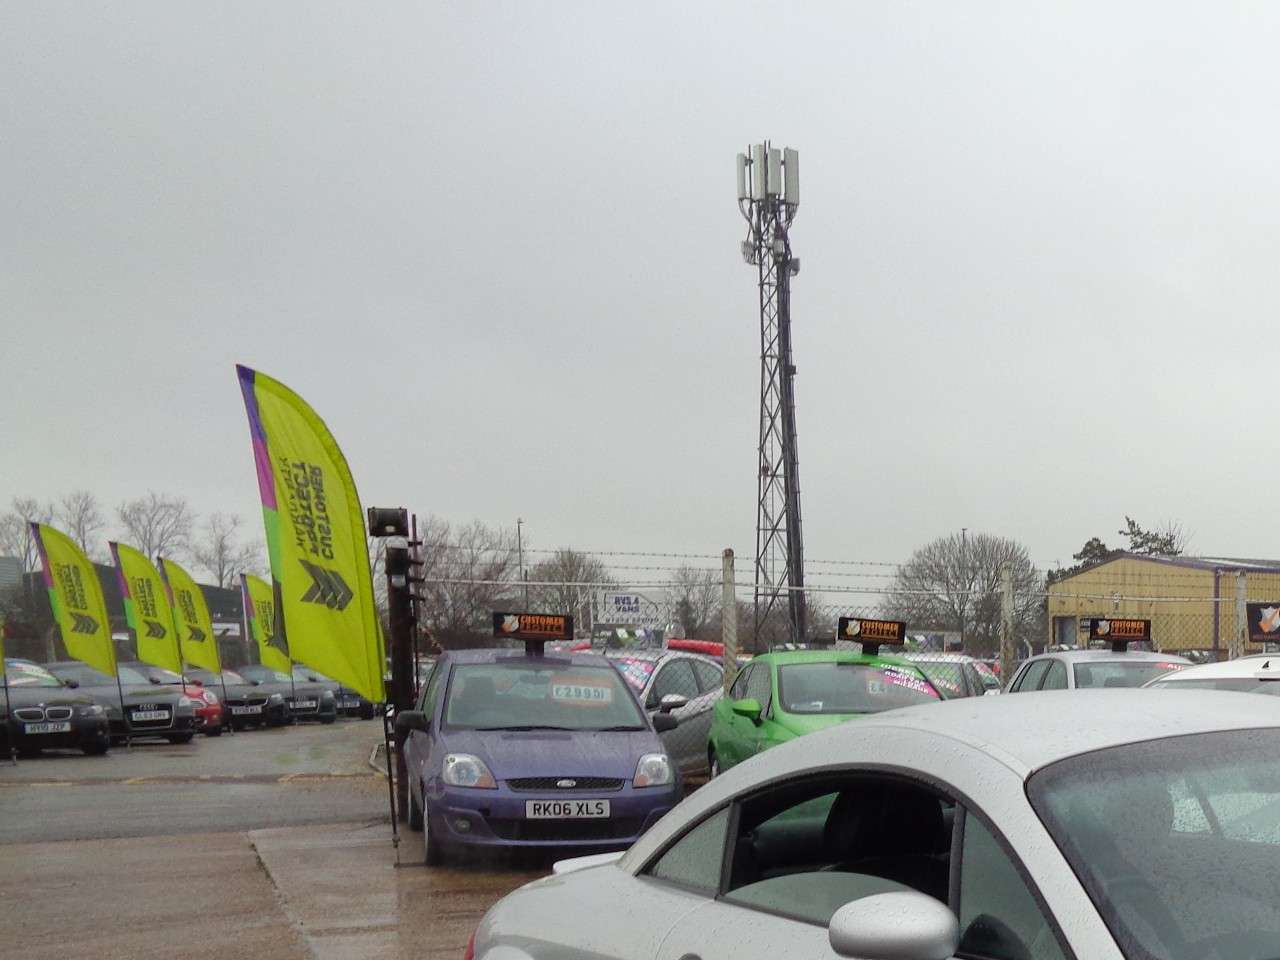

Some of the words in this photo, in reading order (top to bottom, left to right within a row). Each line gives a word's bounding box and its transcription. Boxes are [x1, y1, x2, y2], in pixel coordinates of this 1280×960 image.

[520, 614, 565, 625] CUSTOMER
[861, 620, 899, 631] CUSTOMER
[533, 802, 572, 816] RK06
[575, 802, 604, 816] XLS
